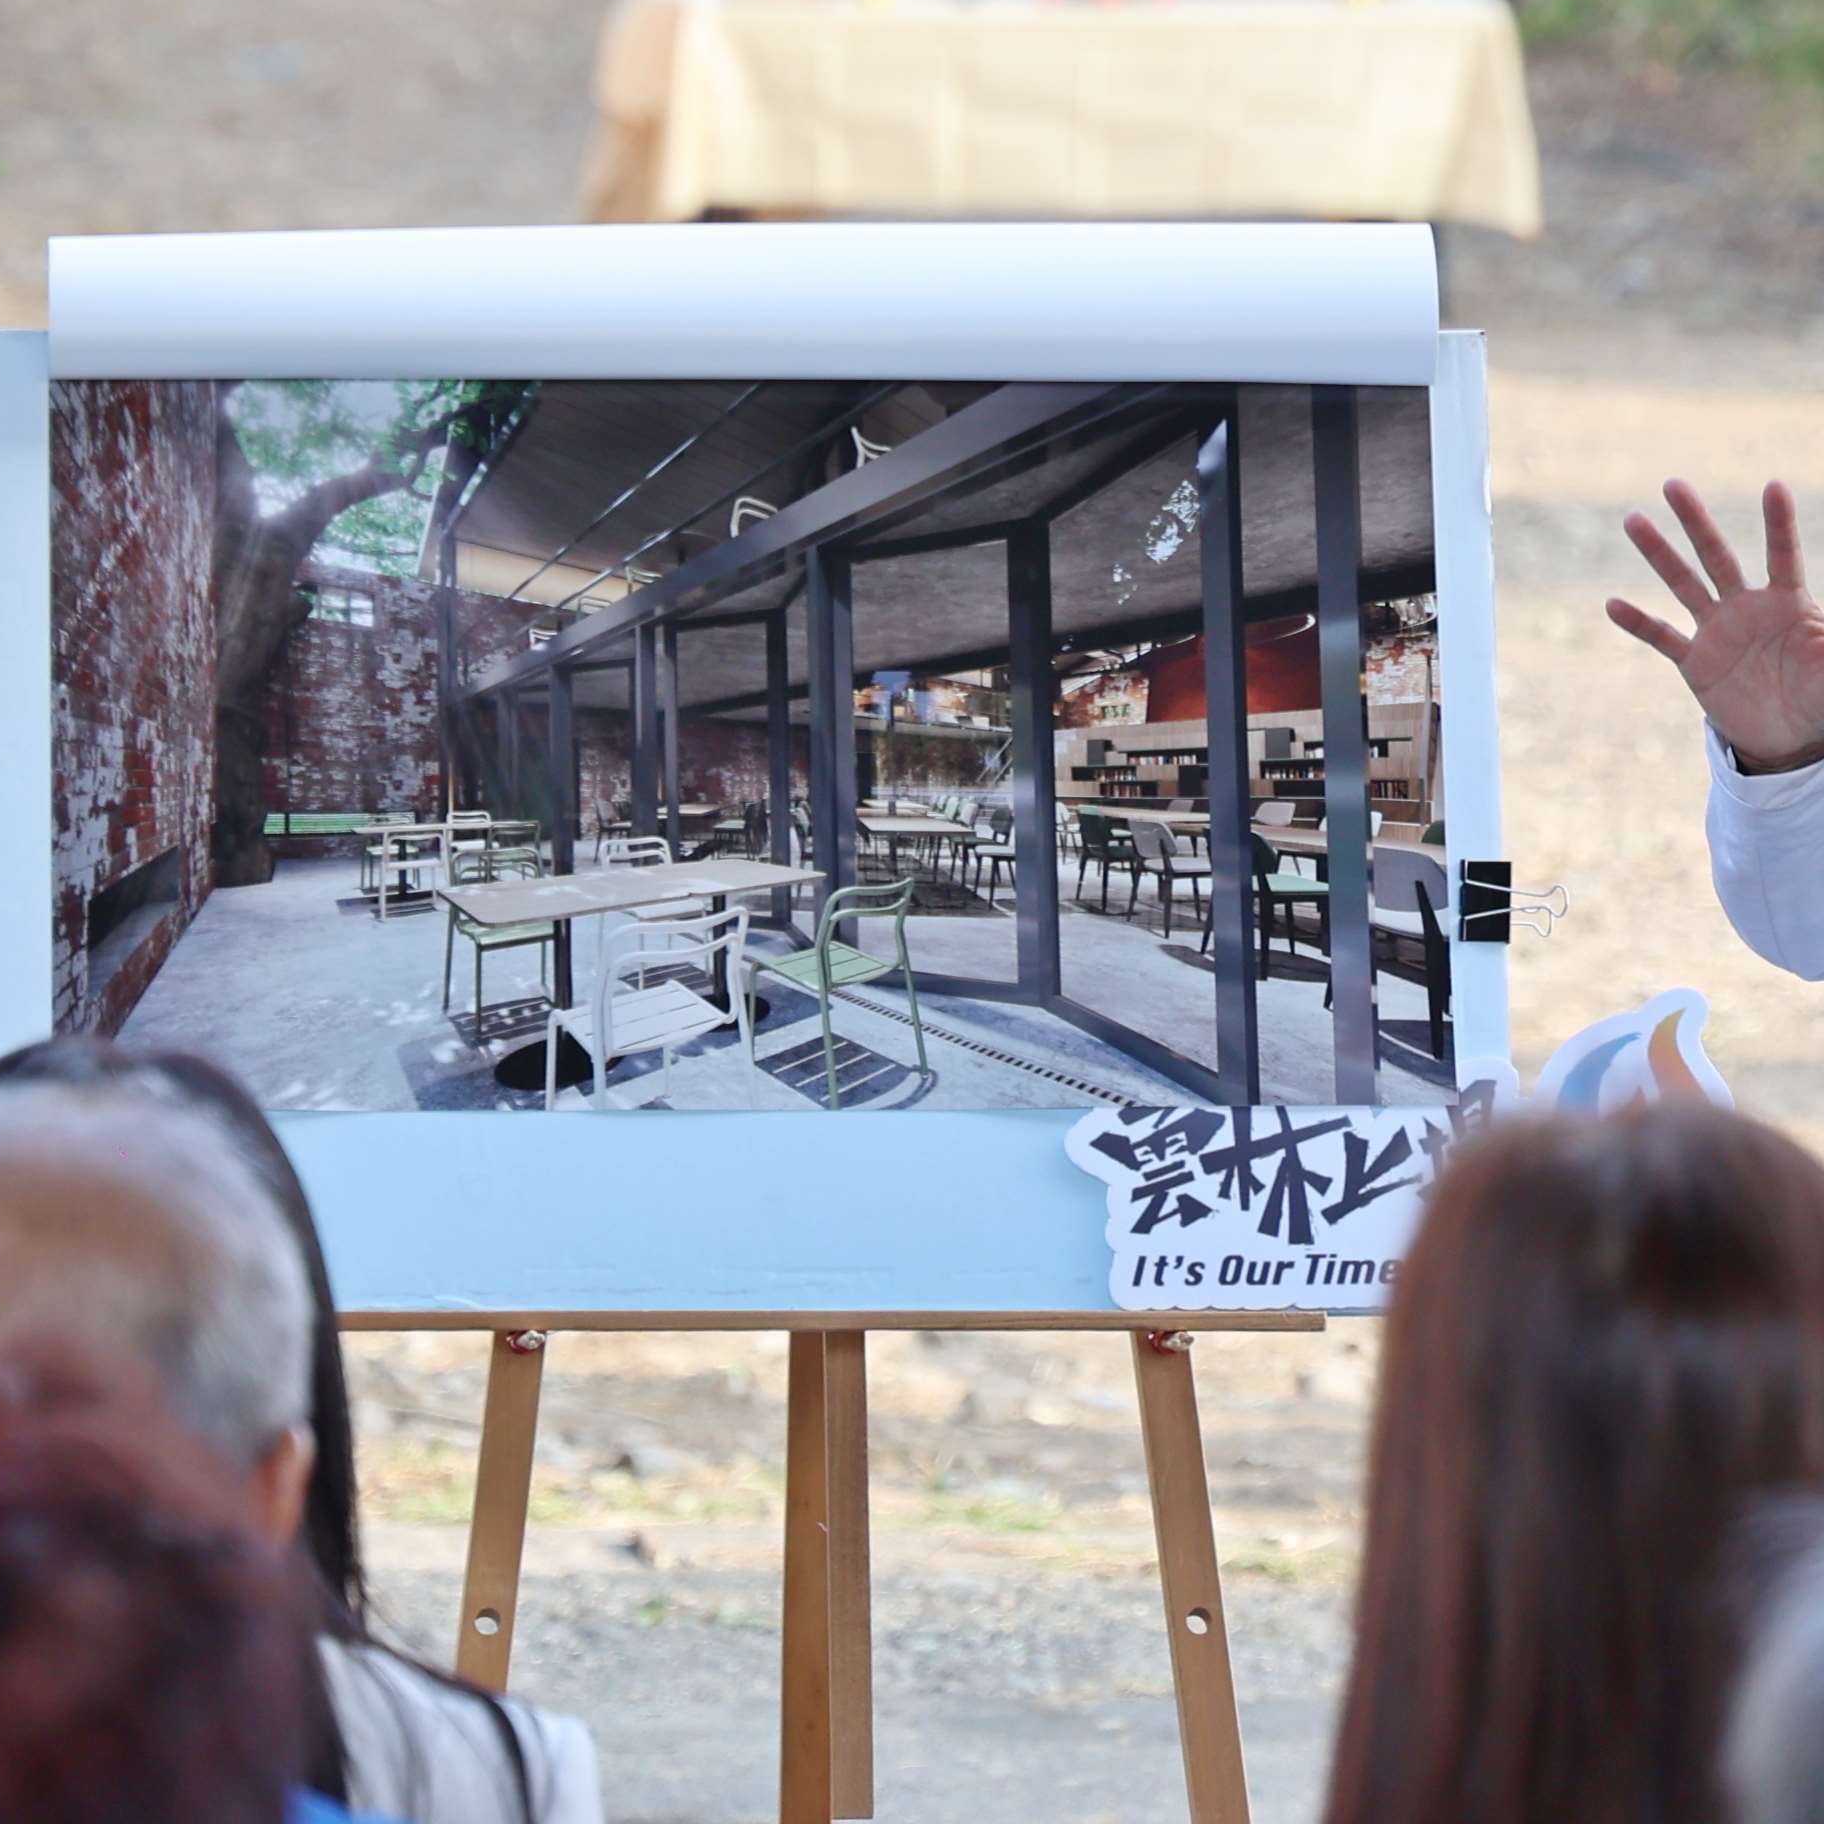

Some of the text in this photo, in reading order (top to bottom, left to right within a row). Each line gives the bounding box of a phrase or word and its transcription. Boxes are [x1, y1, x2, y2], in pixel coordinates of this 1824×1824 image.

[1131, 1253, 1402, 1288] It's Our Time
